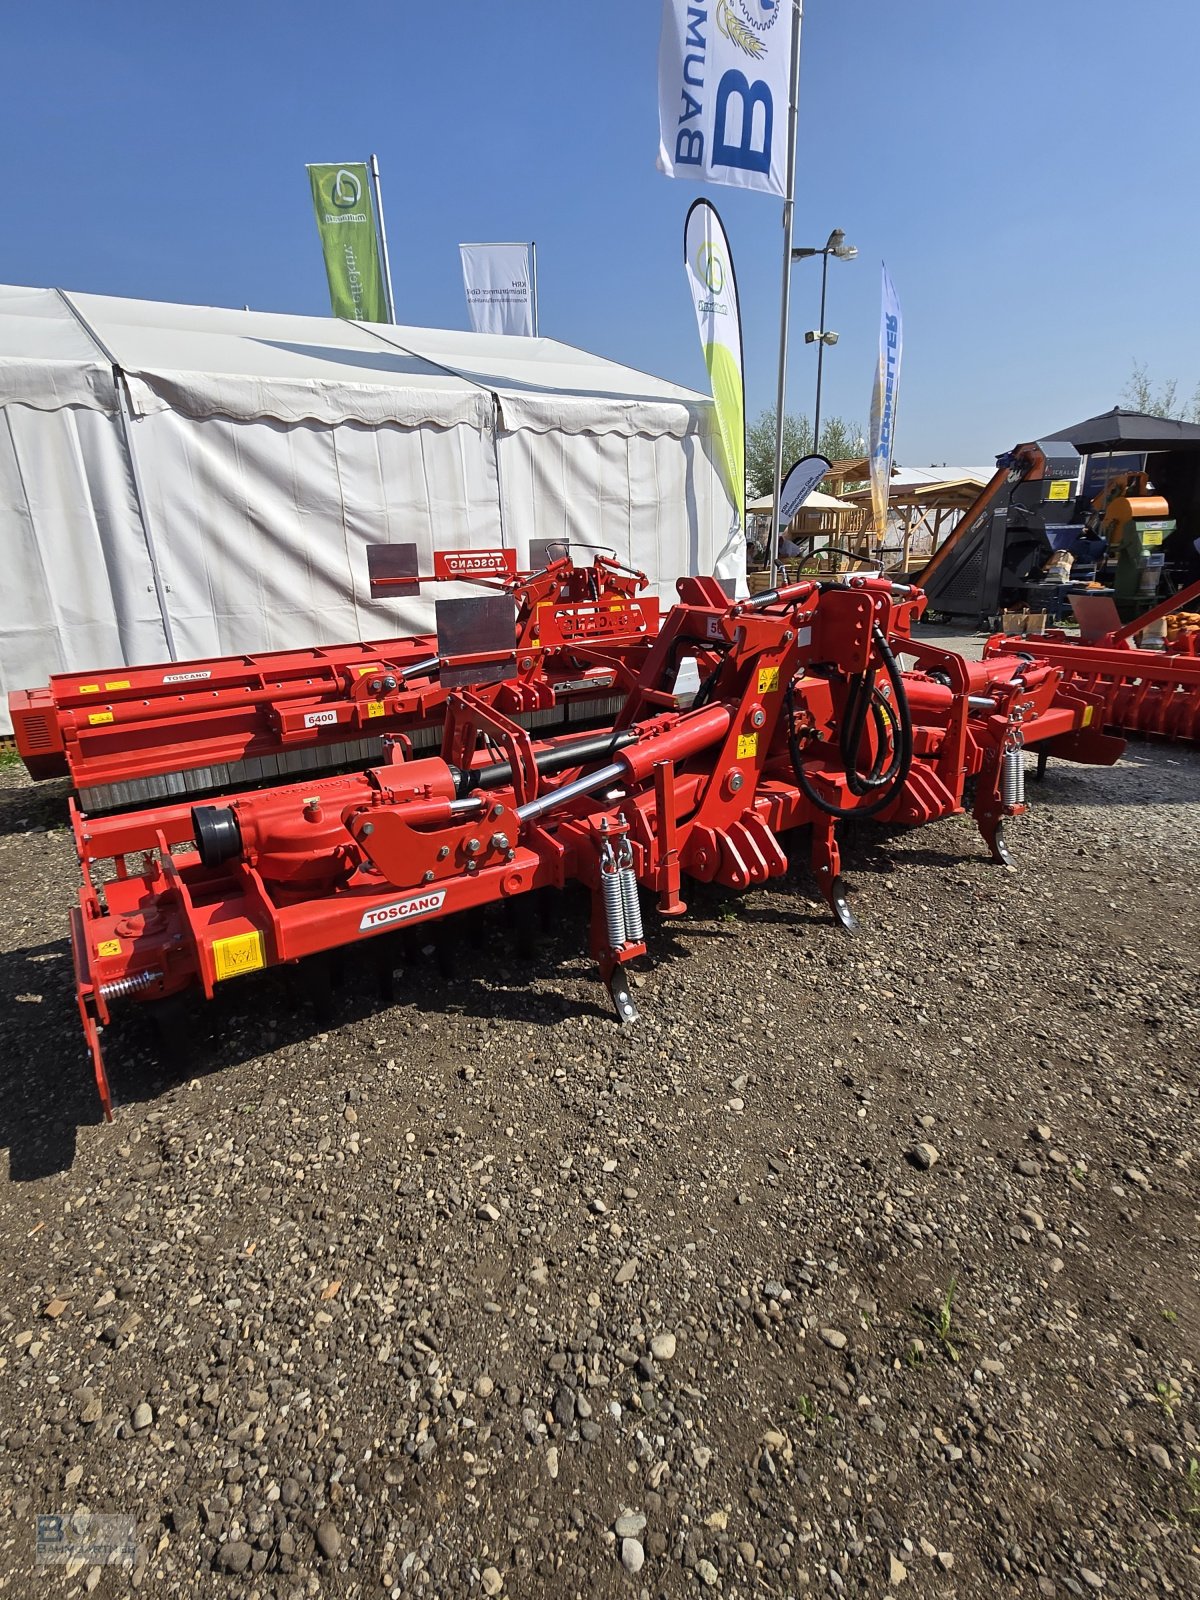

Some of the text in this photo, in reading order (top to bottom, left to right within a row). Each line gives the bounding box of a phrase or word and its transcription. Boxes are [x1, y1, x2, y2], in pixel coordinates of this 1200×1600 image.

[166, 671, 210, 683] TOSCANO
[308, 713, 335, 727] 6400
[367, 896, 440, 924] TOSCANO
